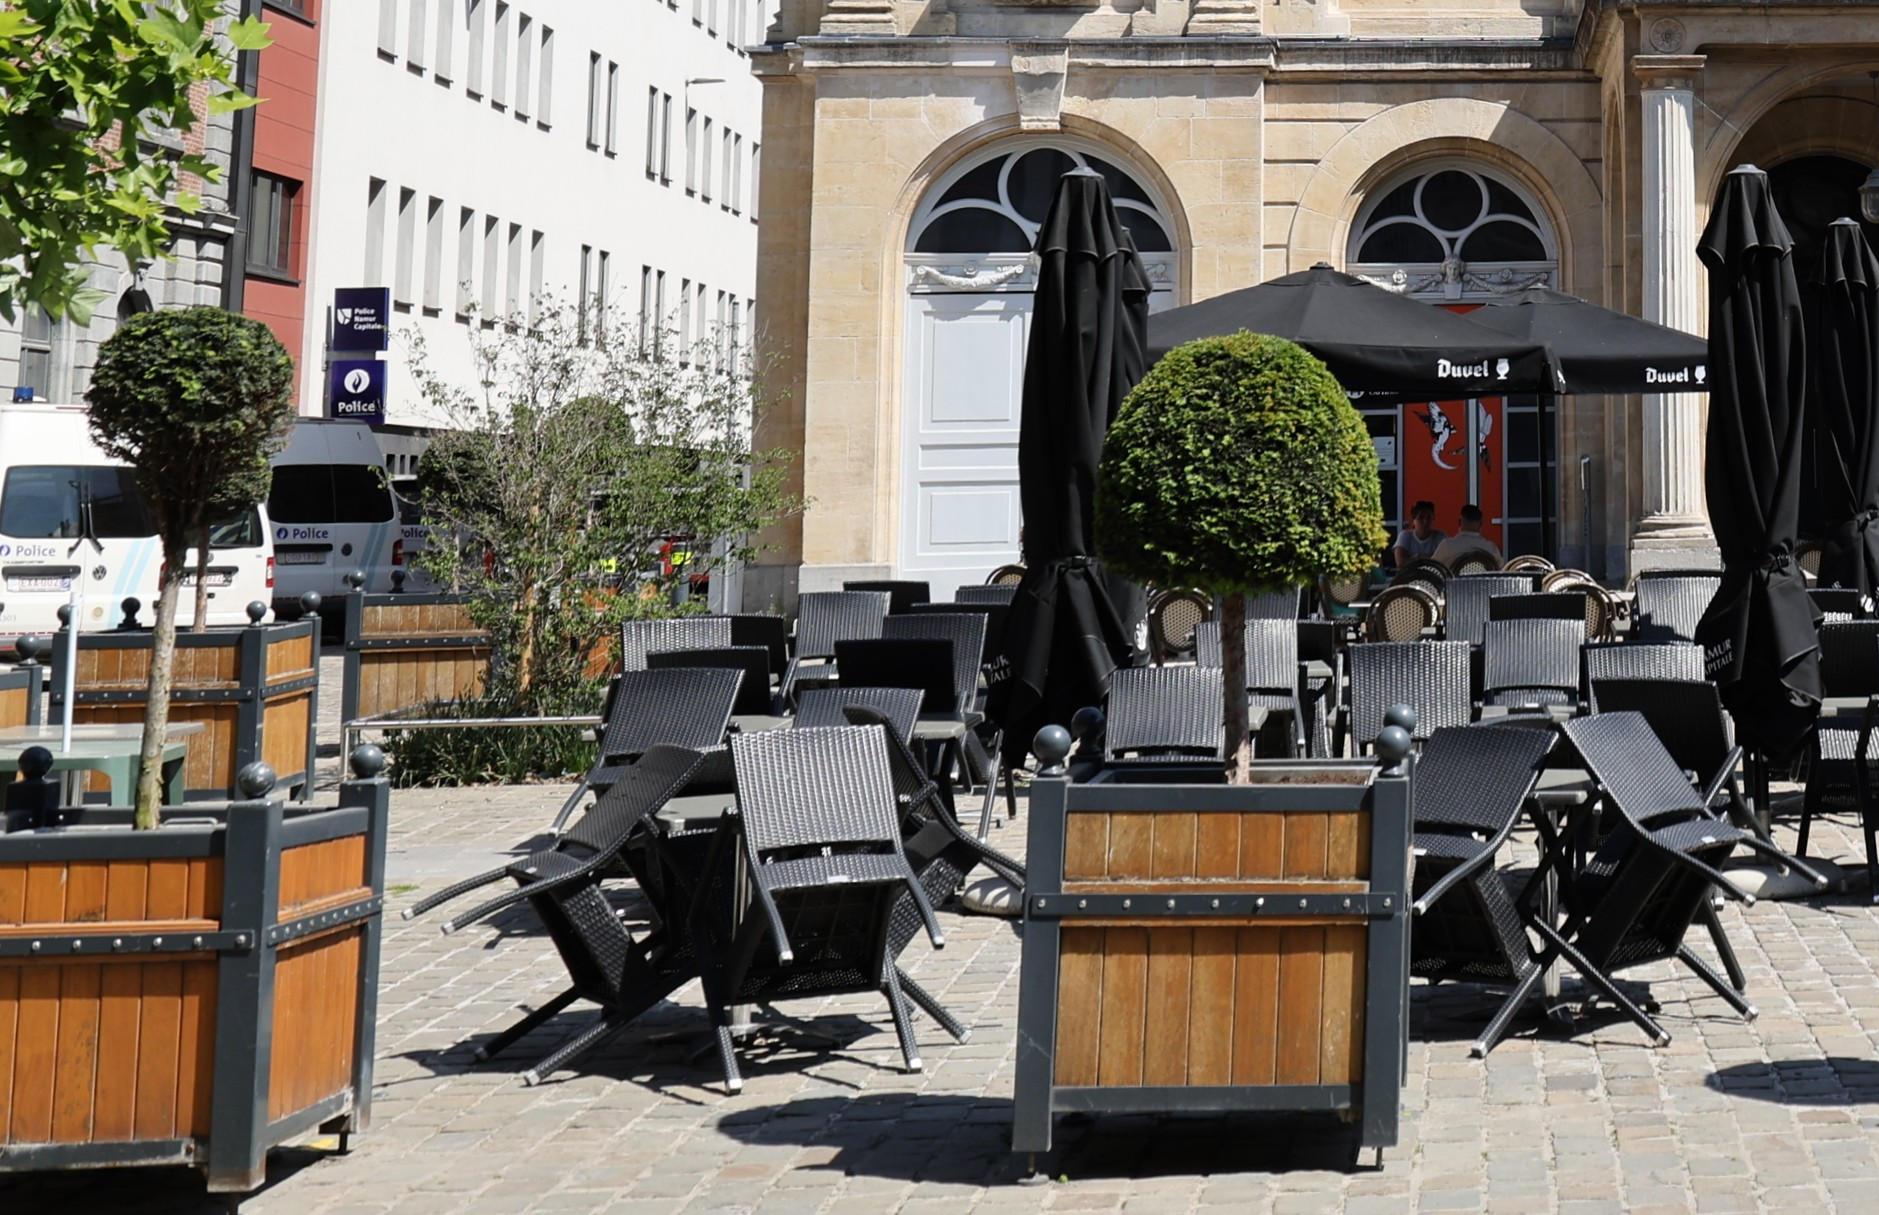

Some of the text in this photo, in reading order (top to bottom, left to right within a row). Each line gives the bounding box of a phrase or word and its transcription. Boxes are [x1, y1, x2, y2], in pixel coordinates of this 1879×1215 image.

[1437, 358, 1489, 379] Duvel
[1645, 367, 1689, 384] Duvel
[338, 400, 376, 413] Police
[292, 528, 329, 539] Police
[401, 528, 430, 538] olice
[15, 544, 56, 557] Police
